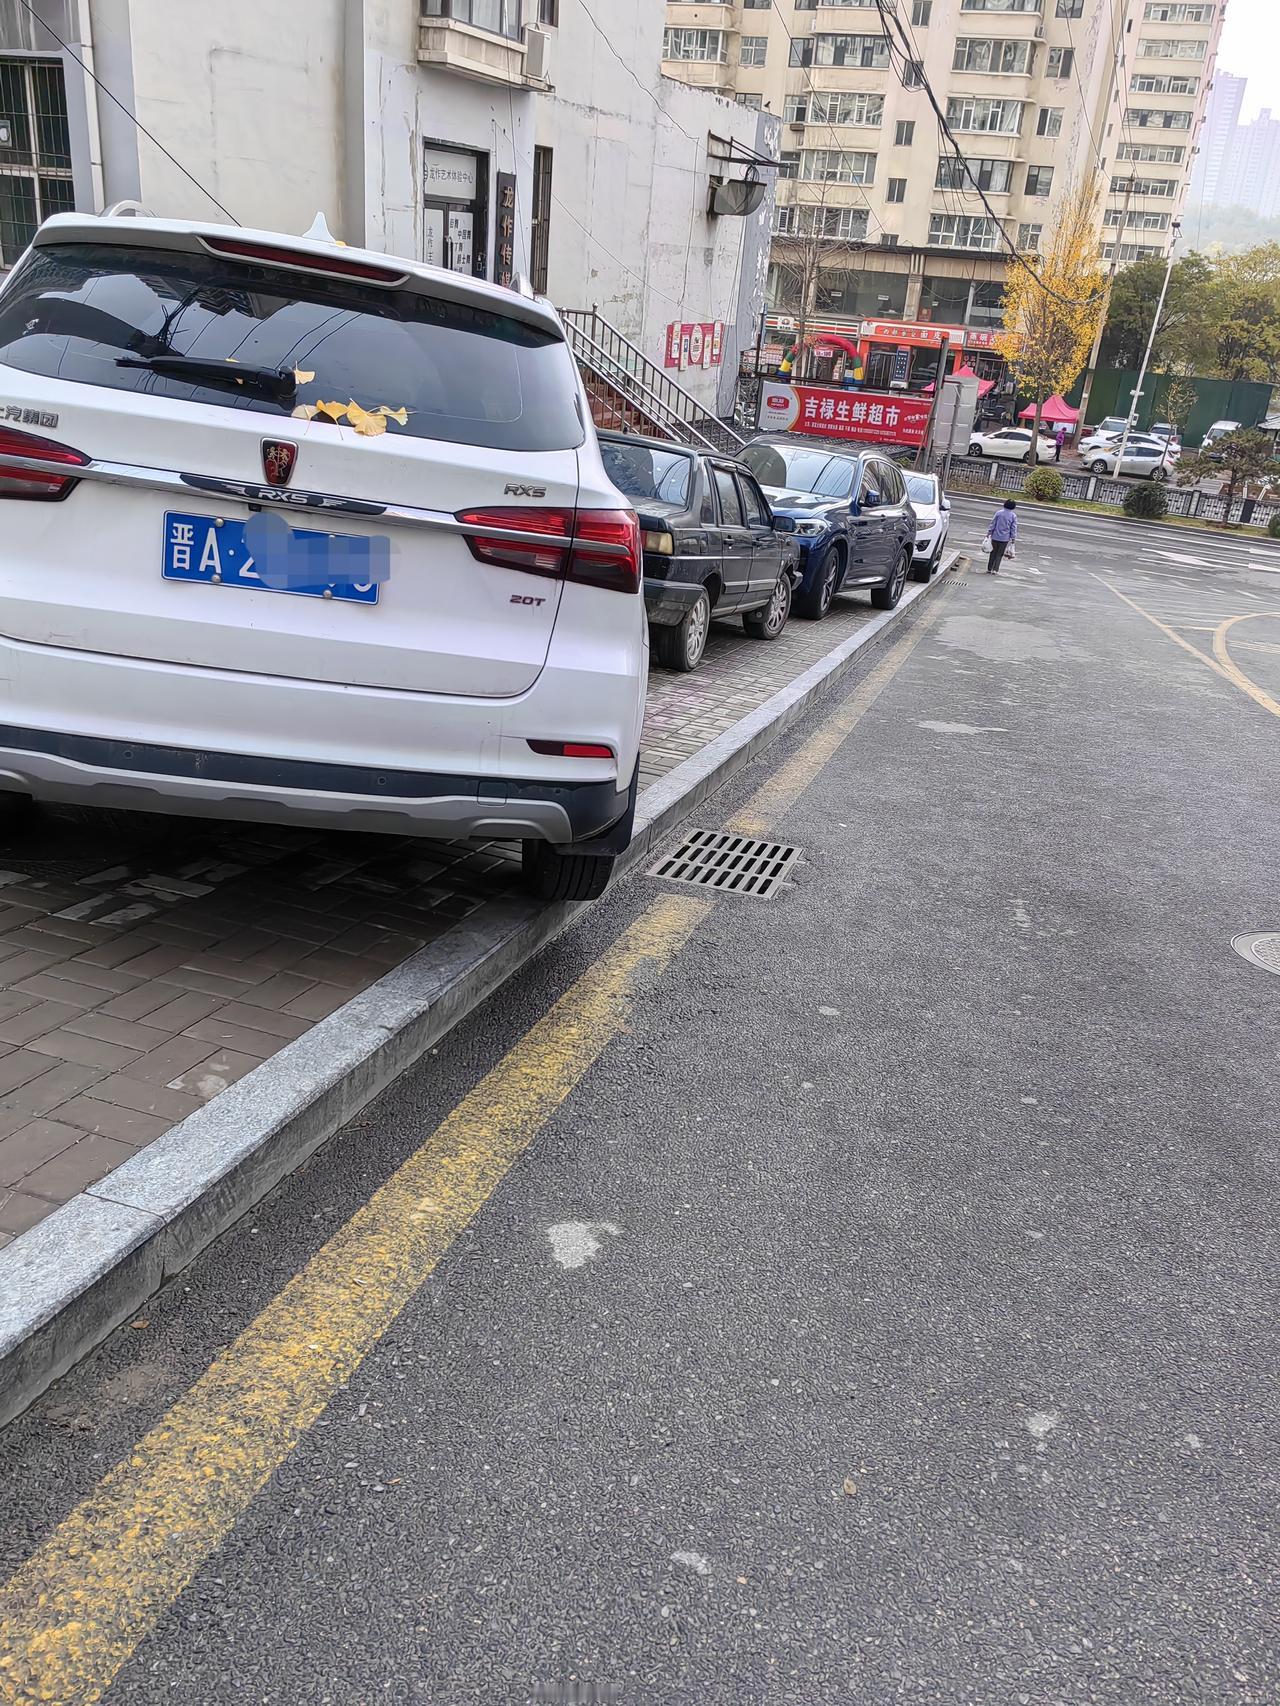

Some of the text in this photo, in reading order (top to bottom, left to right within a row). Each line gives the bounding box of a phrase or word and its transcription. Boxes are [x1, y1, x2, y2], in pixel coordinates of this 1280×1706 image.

[804, 396, 901, 428] 吉禄生鲜超市
[258, 489, 309, 504] RX5
[504, 483, 547, 498] RX5
[509, 595, 546, 607] 20T
